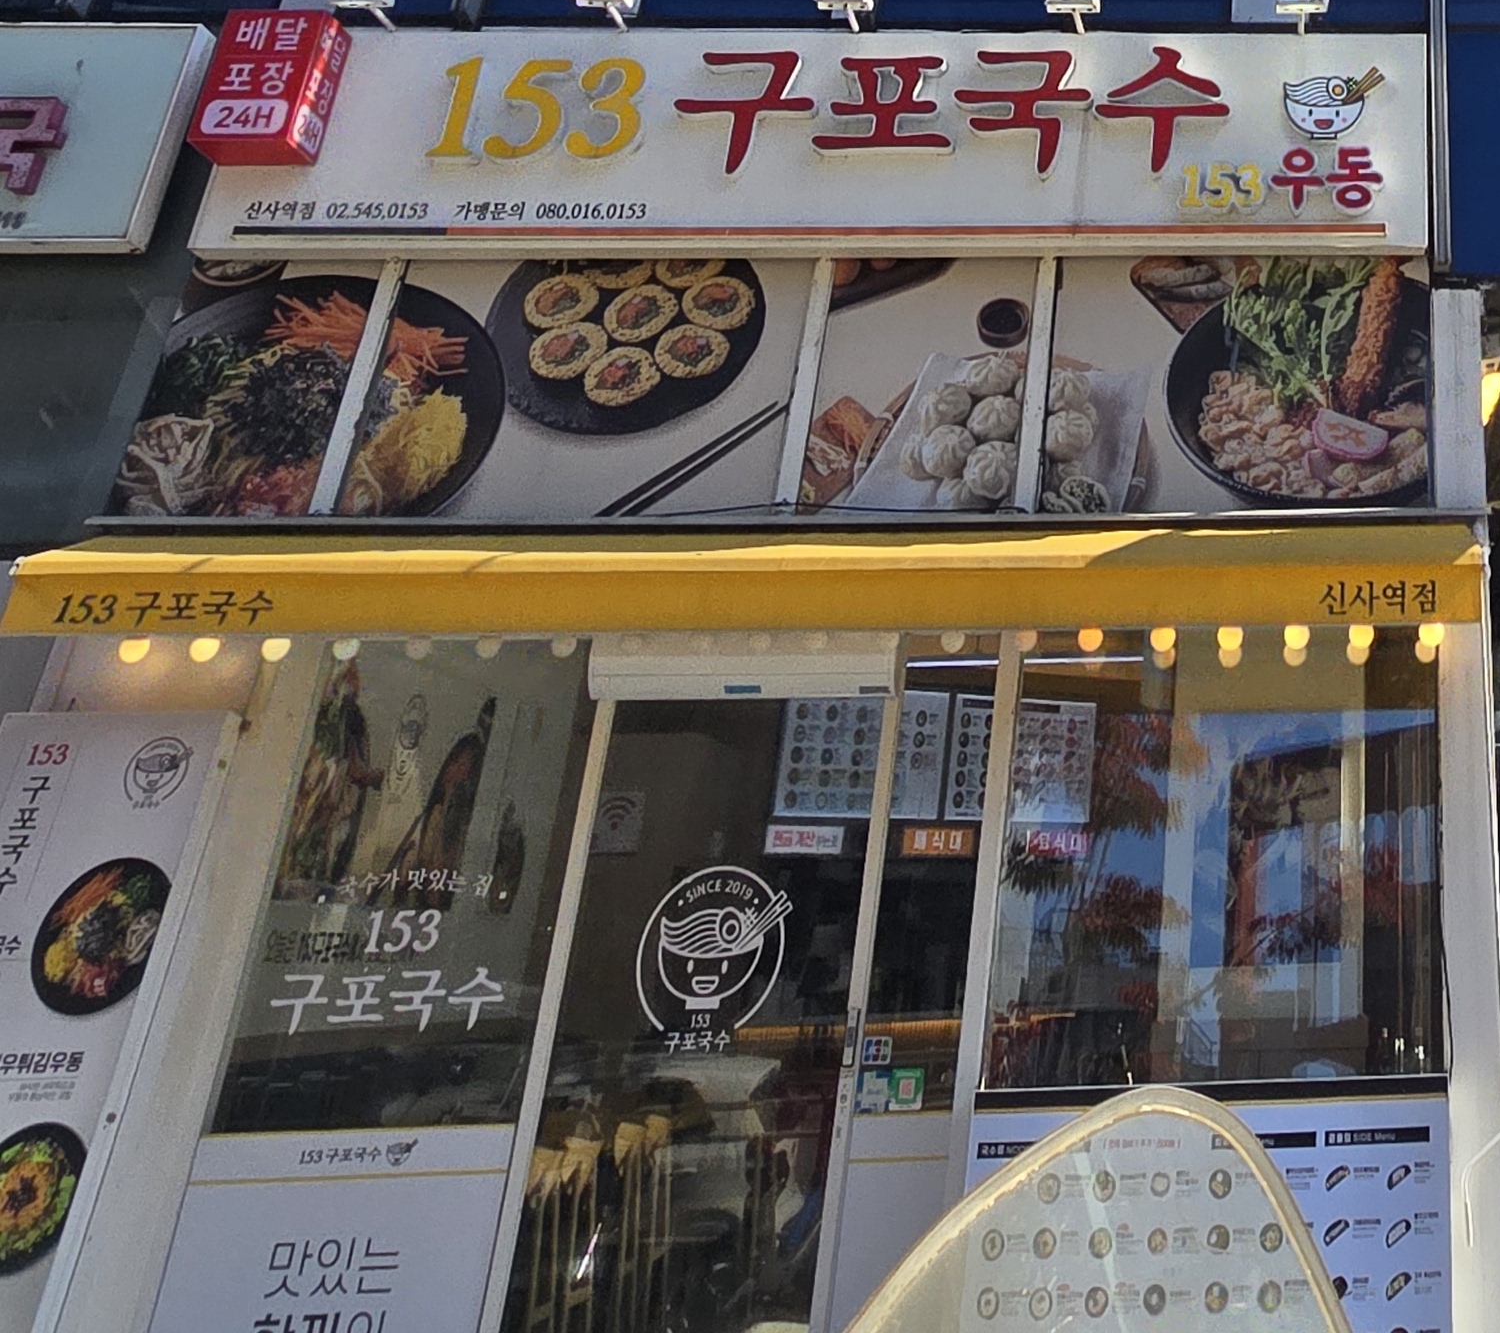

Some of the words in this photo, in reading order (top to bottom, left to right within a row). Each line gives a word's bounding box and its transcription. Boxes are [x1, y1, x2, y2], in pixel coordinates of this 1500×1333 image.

[235, 17, 308, 52] 배달
[218, 61, 295, 96] 포장
[213, 105, 276, 129] 24H
[424, 56, 645, 161] 153
[673, 46, 1232, 179] 구포국수
[1180, 162, 1264, 211] 153
[1271, 146, 1384, 215] 우동
[244, 200, 317, 221] 신사역점
[453, 200, 526, 222] 가맹문의
[535, 201, 648, 221] 080.016.0153
[52, 594, 118, 625] 153
[126, 590, 275, 627] 구포국수
[1318, 580, 1439, 616] 신사역점
[26, 743, 70, 767] 153
[407, 867, 467, 894] 맛있는
[472, 873, 494, 899] 집
[685, 878, 722, 904] SINCE
[725, 880, 754, 901] 2019
[364, 908, 443, 954] 153
[270, 966, 505, 1036] 구포국수
[690, 1013, 711, 1029] 153
[663, 1030, 731, 1054] 구포국수
[299, 1148, 323, 1165] 153
[325, 1146, 382, 1165] 구포국수
[263, 1236, 400, 1300] 맛있는
